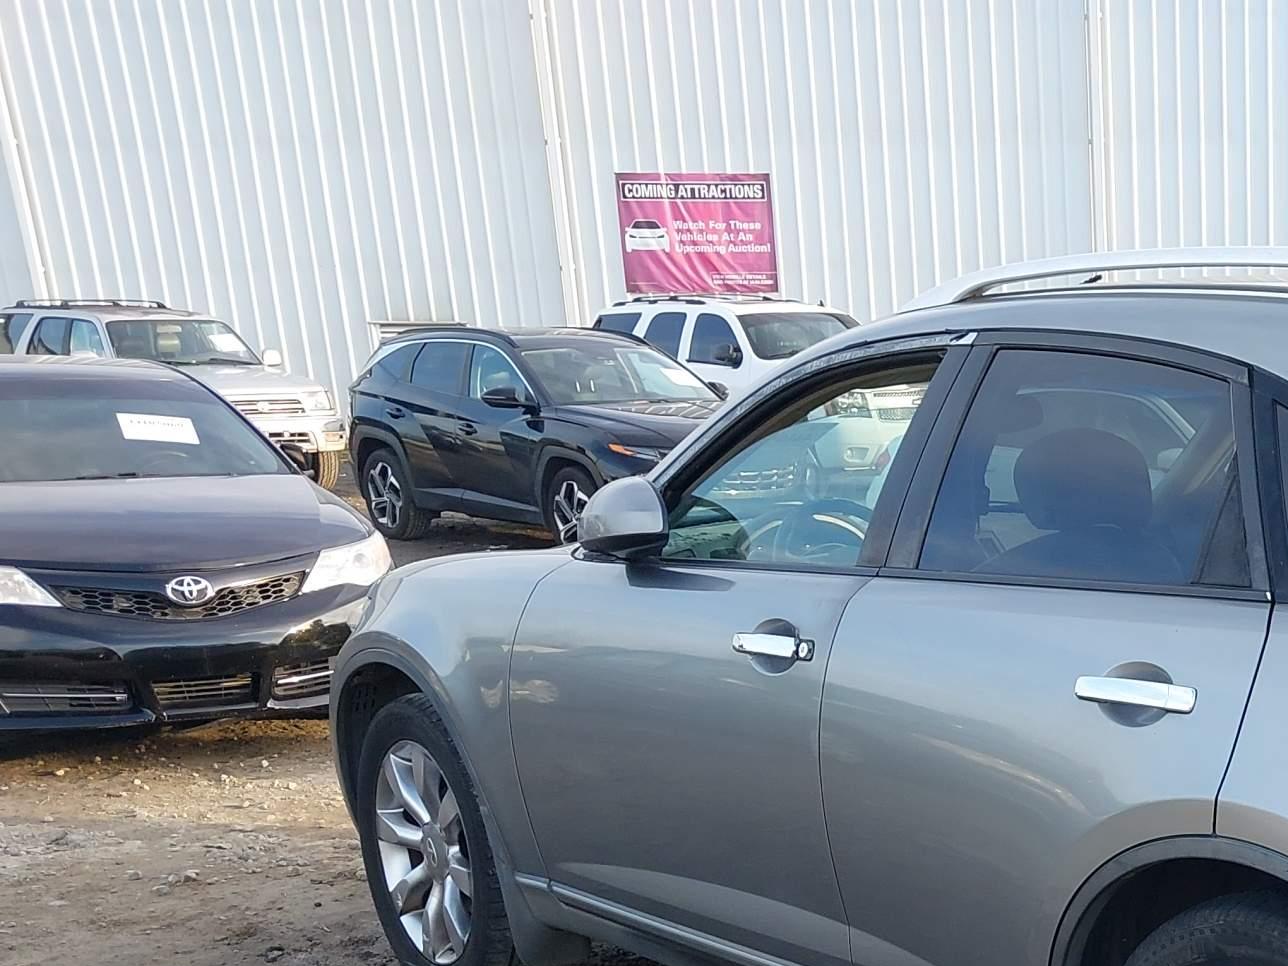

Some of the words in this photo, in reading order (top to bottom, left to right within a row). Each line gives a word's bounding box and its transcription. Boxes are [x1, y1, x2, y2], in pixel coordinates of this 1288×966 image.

[624, 183, 675, 198] COMING
[677, 184, 763, 198] ATTRACTIONS
[673, 220, 706, 230] Watch
[708, 220, 727, 230] For
[729, 220, 762, 230] These
[675, 231, 719, 241] Vehicles
[721, 231, 735, 241] At
[738, 231, 753, 241] An
[675, 243, 726, 255] Upcoming
[727, 243, 771, 253] Auction!
